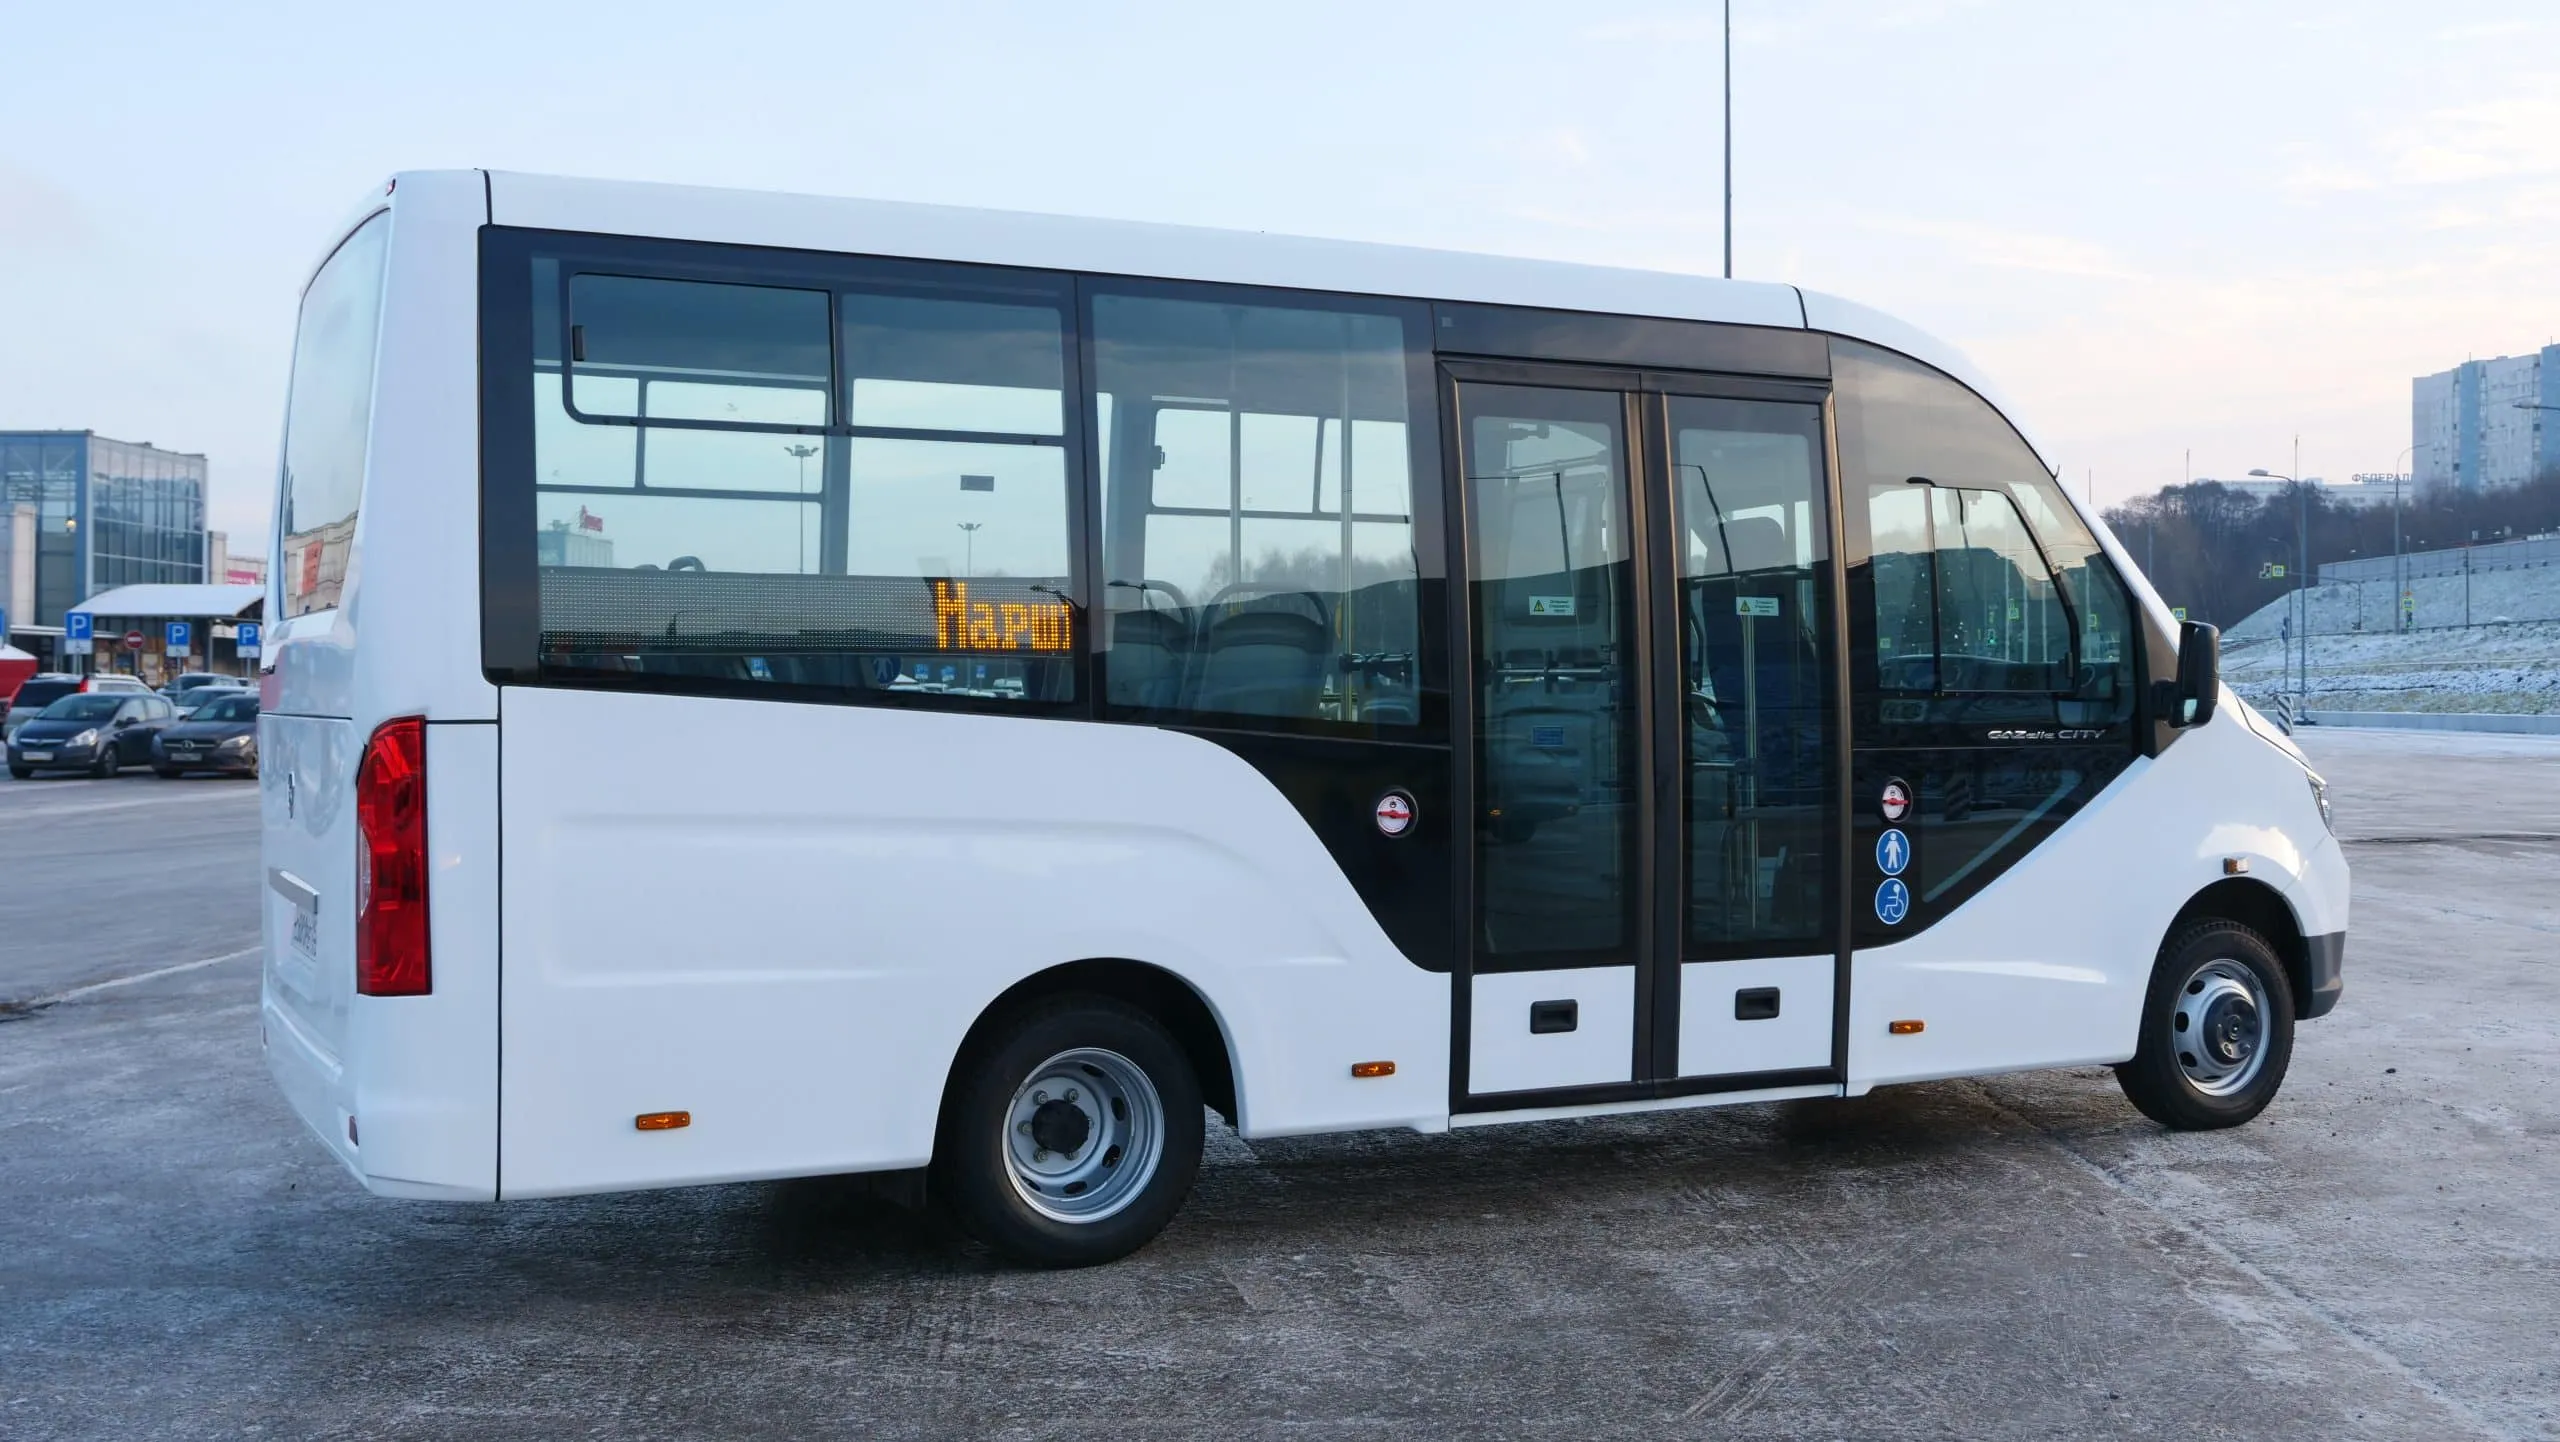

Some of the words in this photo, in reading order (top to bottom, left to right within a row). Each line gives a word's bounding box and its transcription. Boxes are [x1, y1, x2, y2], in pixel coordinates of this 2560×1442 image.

[2351, 472, 2412, 484] ФЕДЕРАЛ
[938, 582, 1070, 649] Марш
[71, 615, 87, 637] P
[171, 625, 185, 644] P
[241, 626, 255, 644] P
[2058, 729, 2106, 739] CITY
